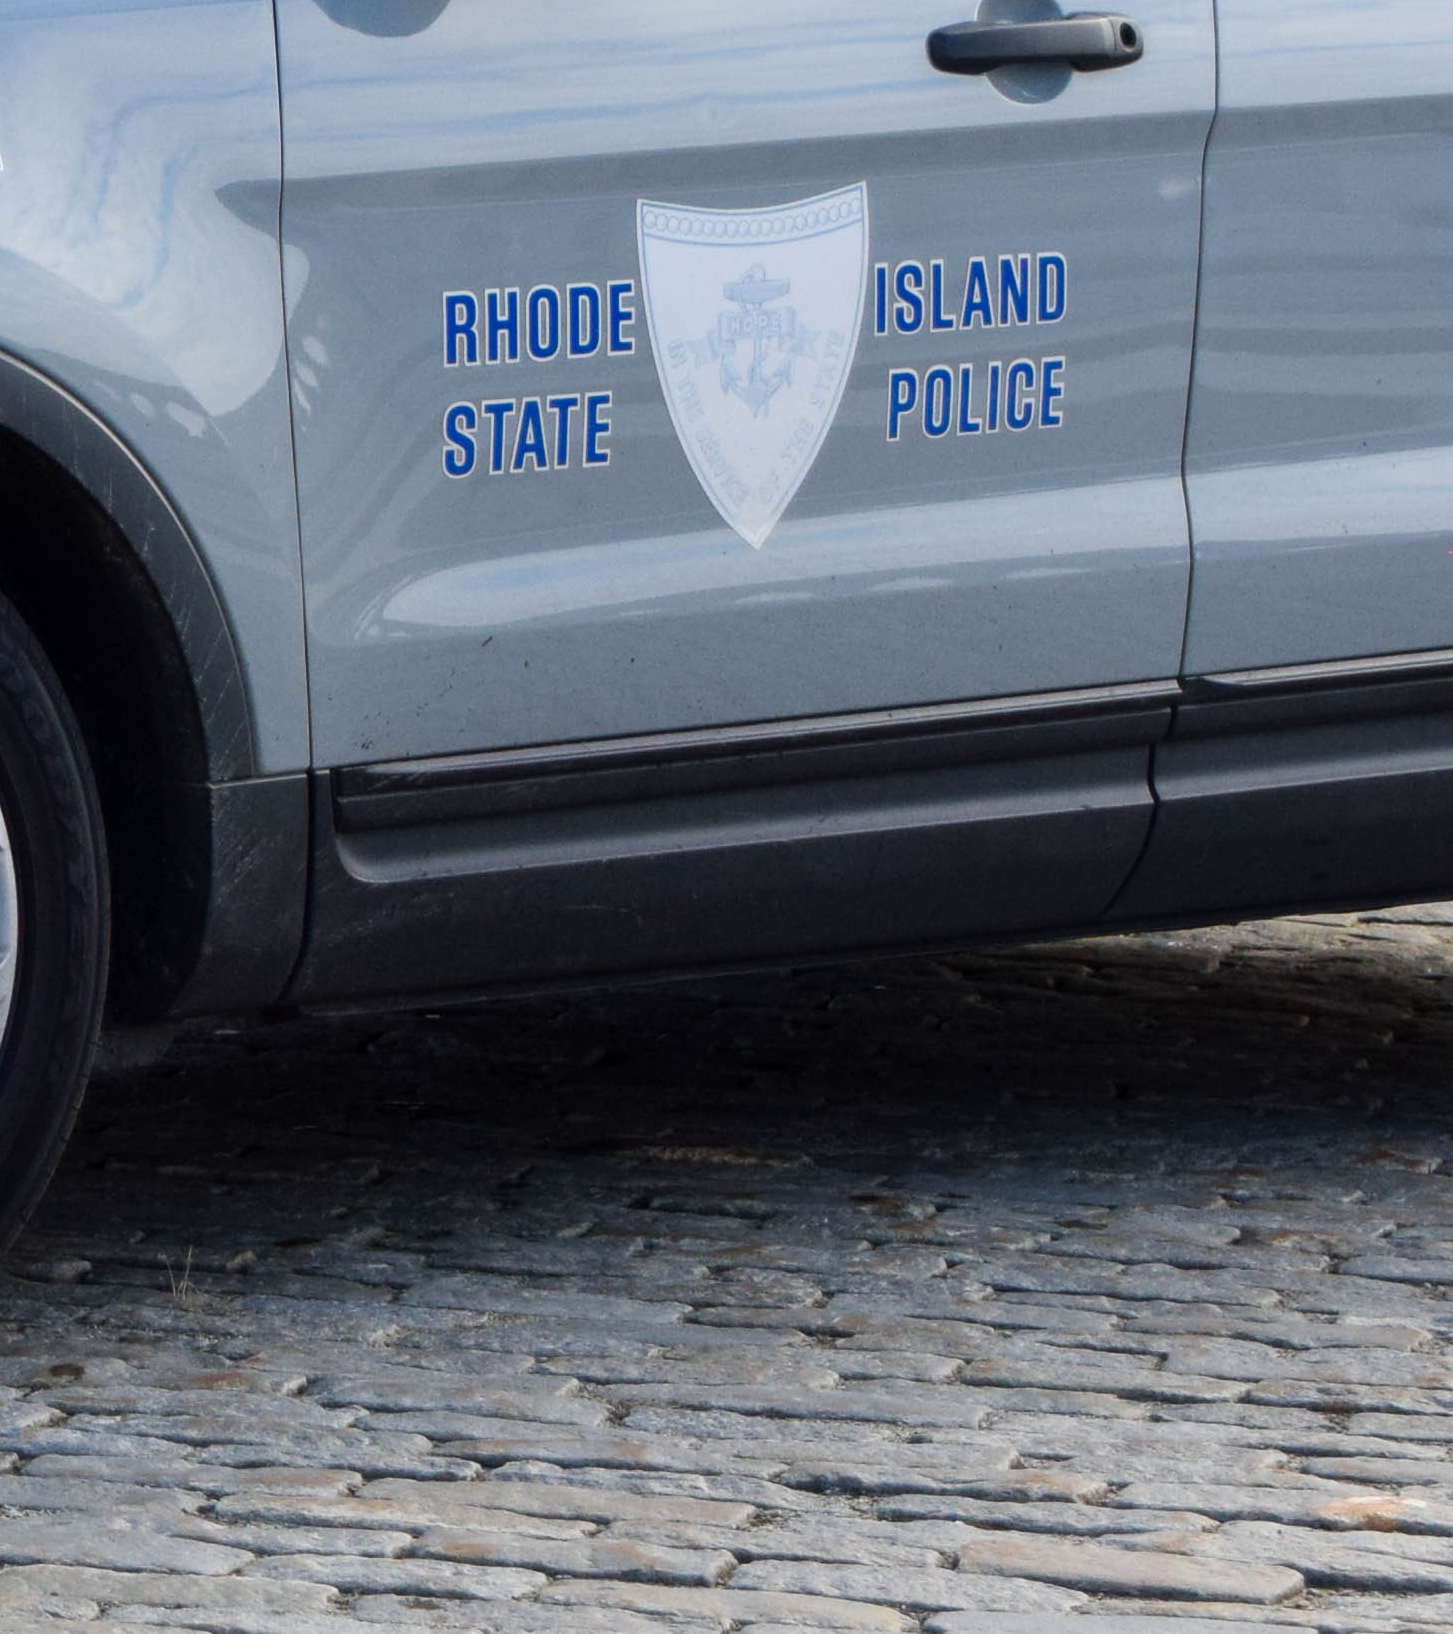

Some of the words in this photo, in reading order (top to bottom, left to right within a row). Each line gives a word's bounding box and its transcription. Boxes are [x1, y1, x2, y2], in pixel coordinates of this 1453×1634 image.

[441, 279, 635, 368] RHODE
[873, 250, 1067, 336] ISLAND
[441, 390, 613, 479] STATE
[886, 356, 1067, 442] POLICE
